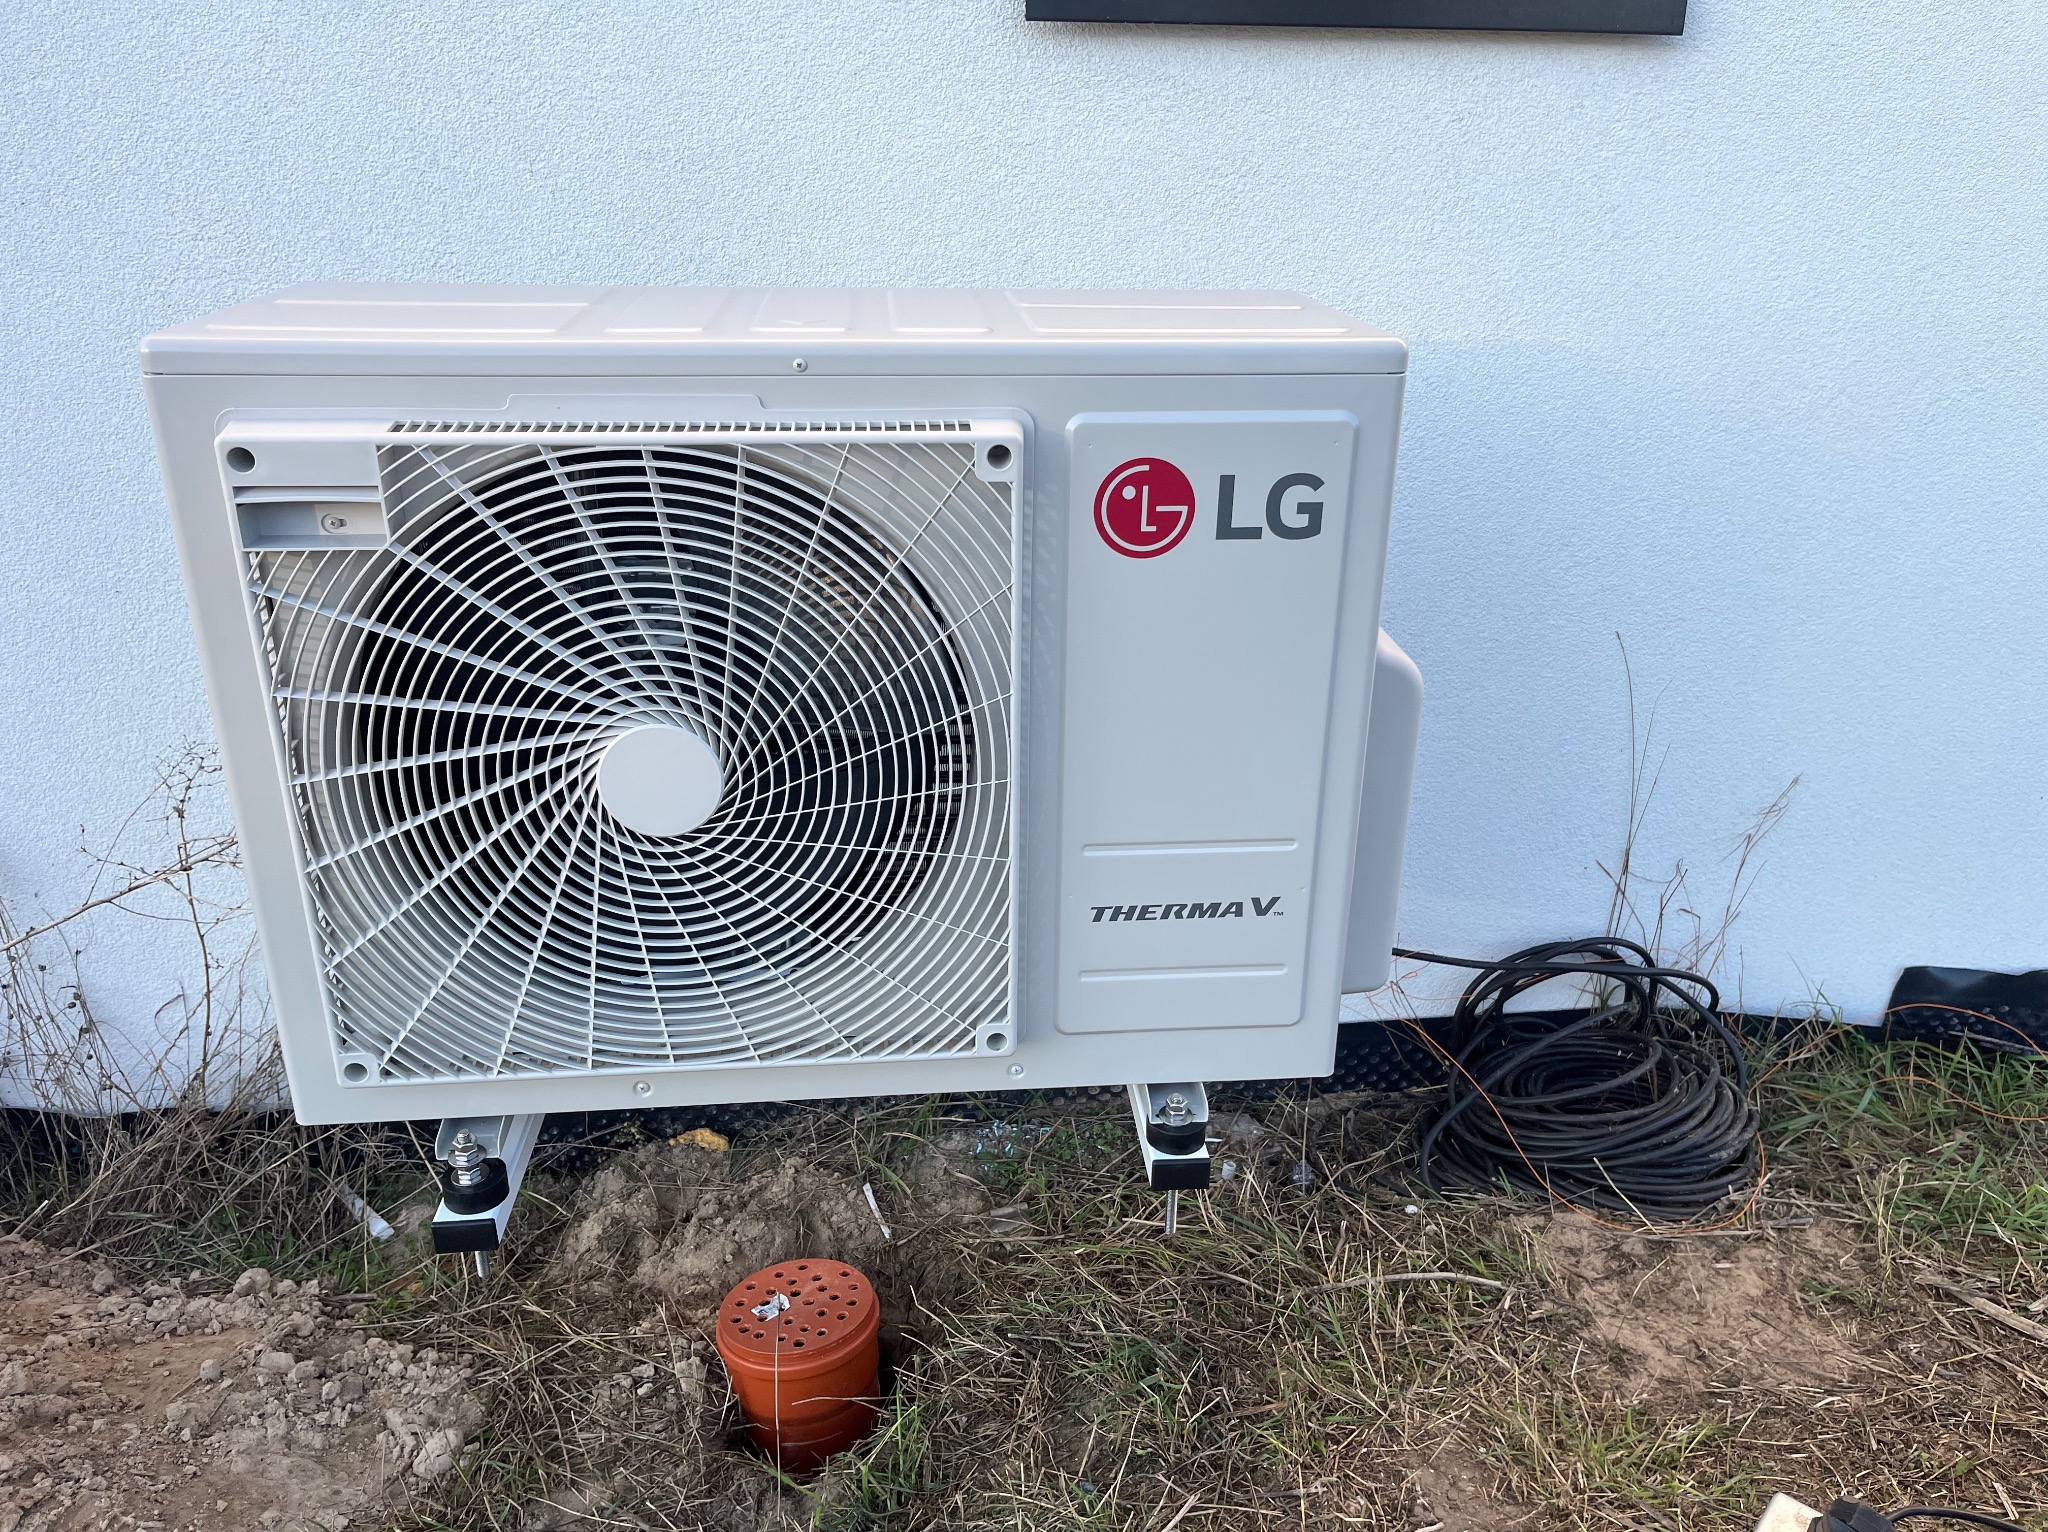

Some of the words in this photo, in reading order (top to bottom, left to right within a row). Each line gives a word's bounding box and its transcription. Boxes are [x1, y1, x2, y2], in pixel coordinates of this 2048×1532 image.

[1101, 464, 1189, 552] LG
[1215, 472, 1325, 540] LG
[1090, 901, 1244, 922] THERMA
